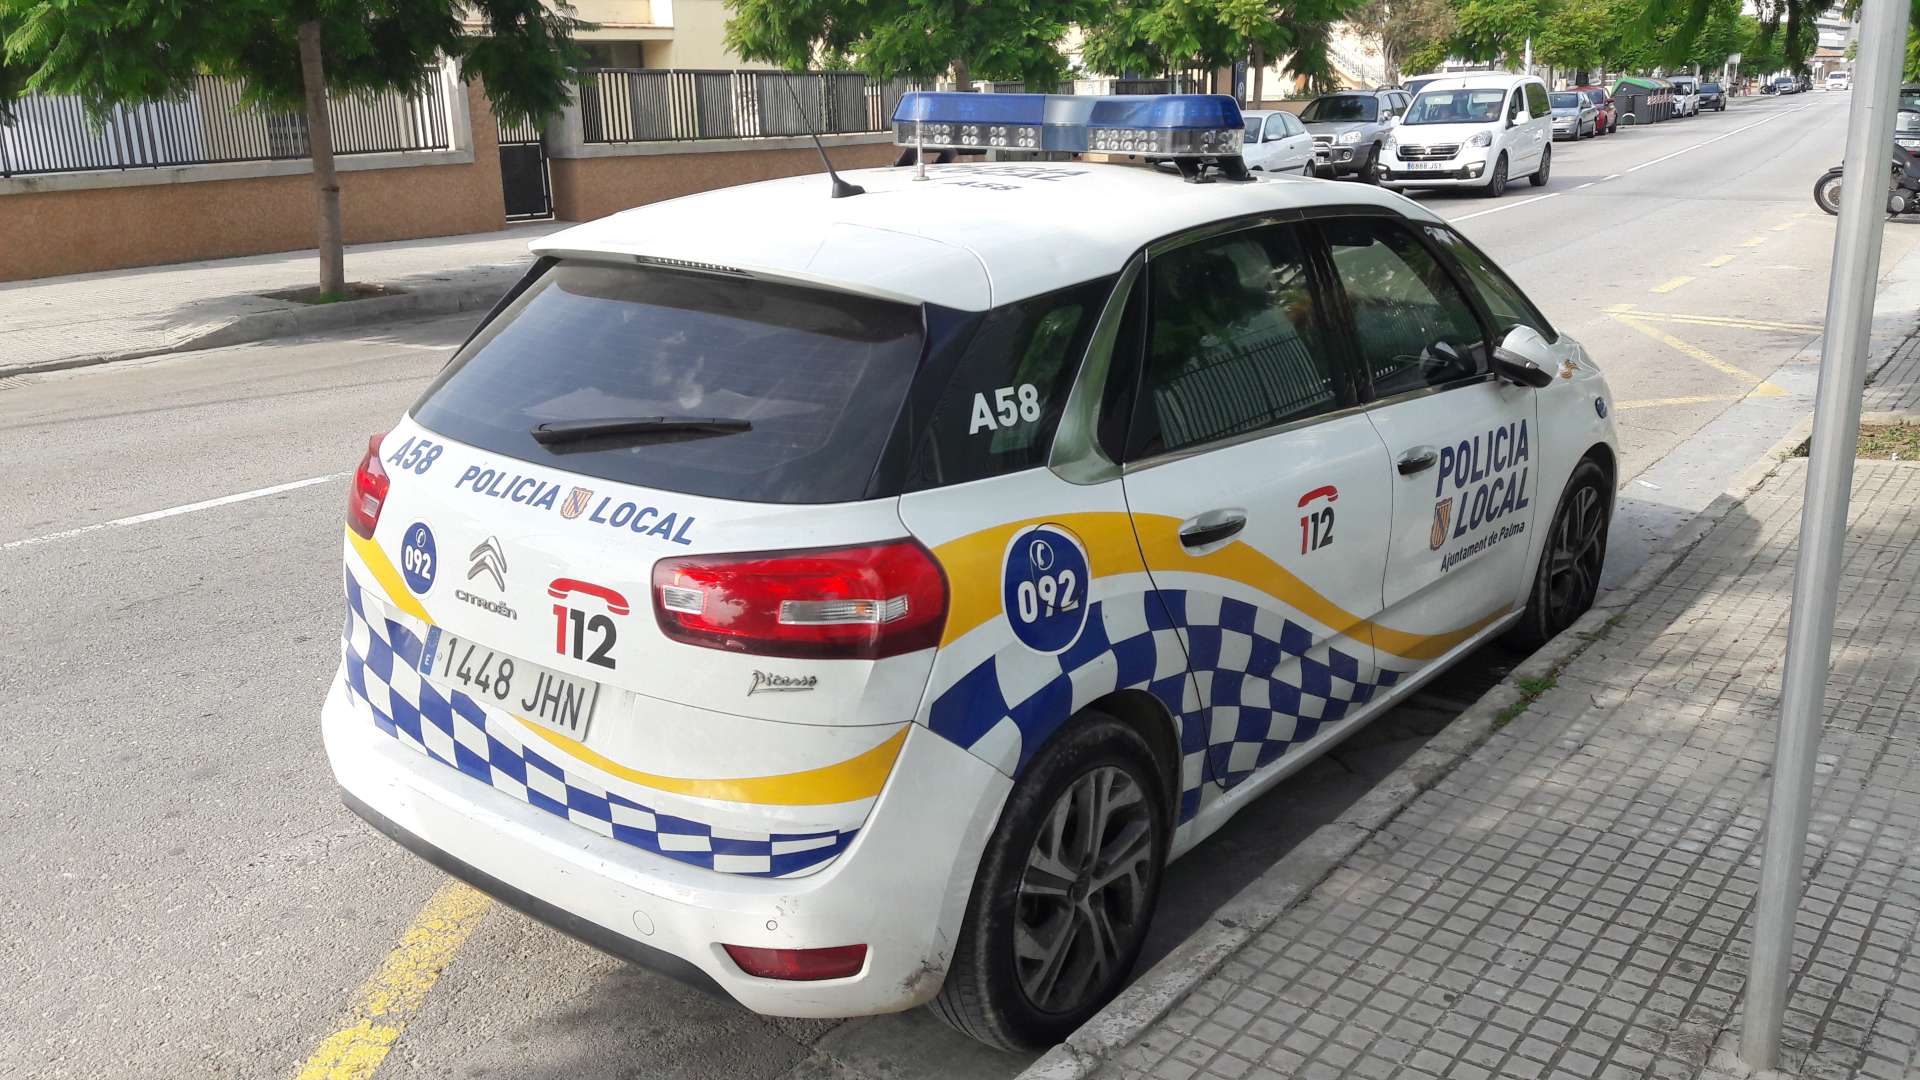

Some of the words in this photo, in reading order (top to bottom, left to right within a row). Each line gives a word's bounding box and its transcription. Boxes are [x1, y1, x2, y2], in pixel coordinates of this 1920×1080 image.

[943, 181, 1022, 191] A58
[969, 384, 1041, 435] A58
[387, 436, 444, 475] A58
[1435, 418, 1529, 498] POLICIA
[455, 465, 562, 511] POLICIA
[588, 496, 697, 546] LOCAL
[1452, 467, 1529, 539] LOCAL
[1300, 506, 1335, 555] 112
[1440, 536, 1487, 573] Ajuntament
[1487, 531, 1498, 547] de
[1498, 521, 1525, 542] Palma
[404, 545, 432, 581] 092
[1017, 569, 1079, 624] 092
[552, 603, 617, 670] 112
[443, 637, 515, 701] 1448
[521, 671, 586, 731] JHN
[747, 670, 818, 697] Picasso
